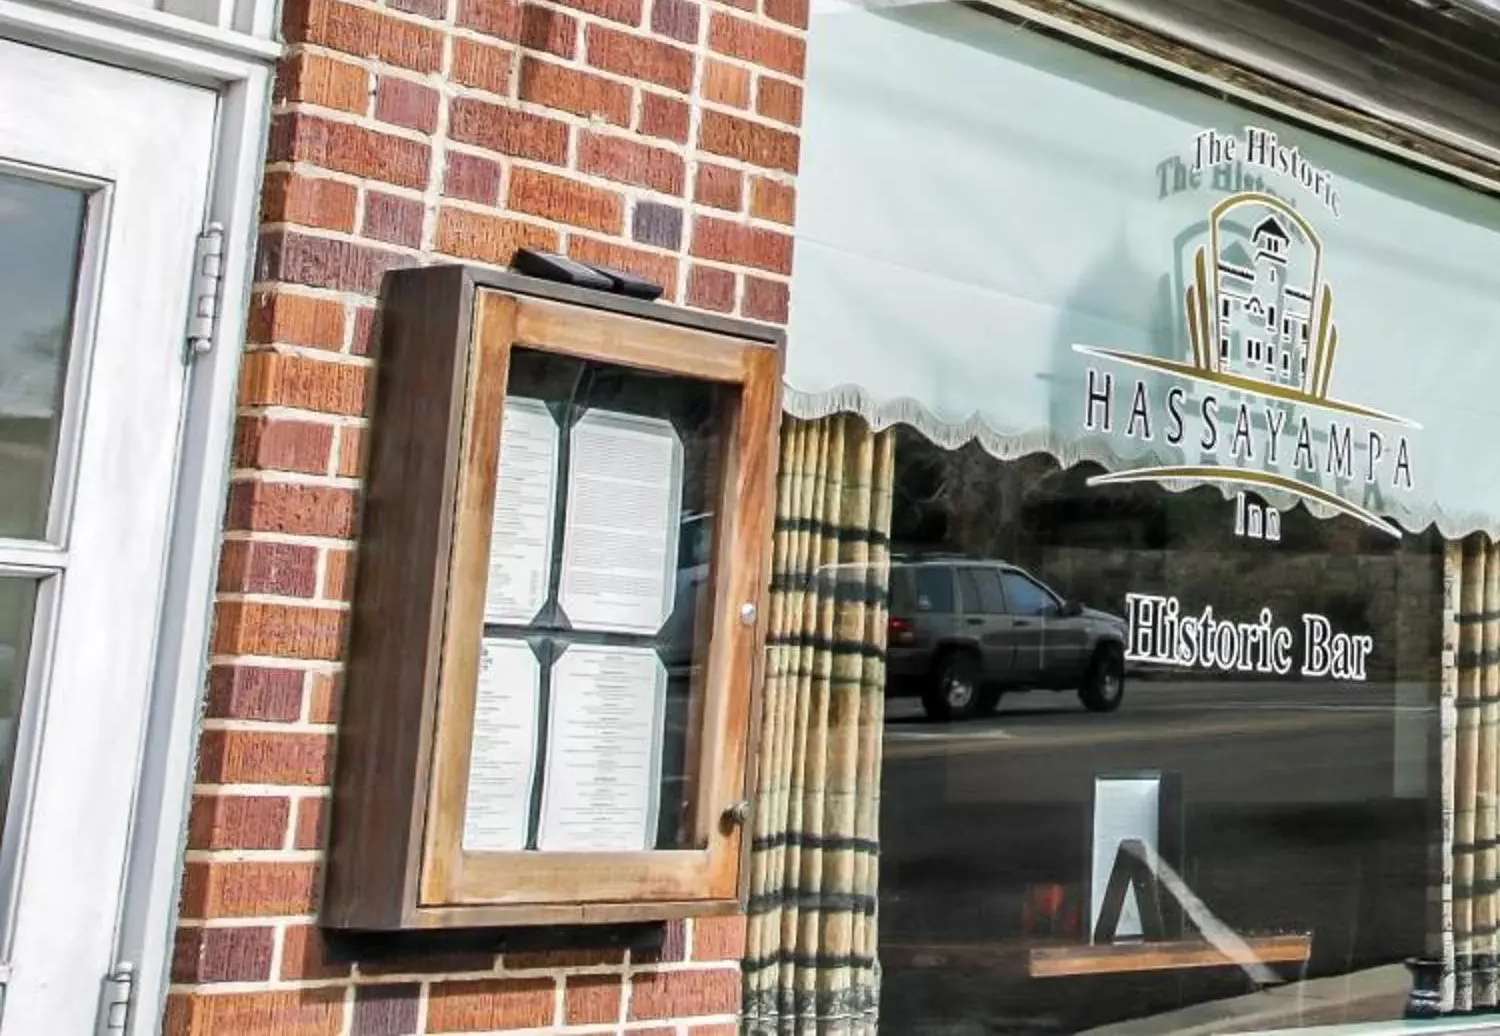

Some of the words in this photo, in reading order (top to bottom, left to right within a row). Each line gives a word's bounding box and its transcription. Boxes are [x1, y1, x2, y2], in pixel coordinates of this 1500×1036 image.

[1193, 131, 1236, 173] The
[1246, 126, 1342, 219] Historic
[1085, 370, 1414, 491] HASSAYAMPA
[1235, 492, 1282, 542] Inn
[1124, 593, 1292, 674] Historic
[1302, 613, 1373, 681] Bar
